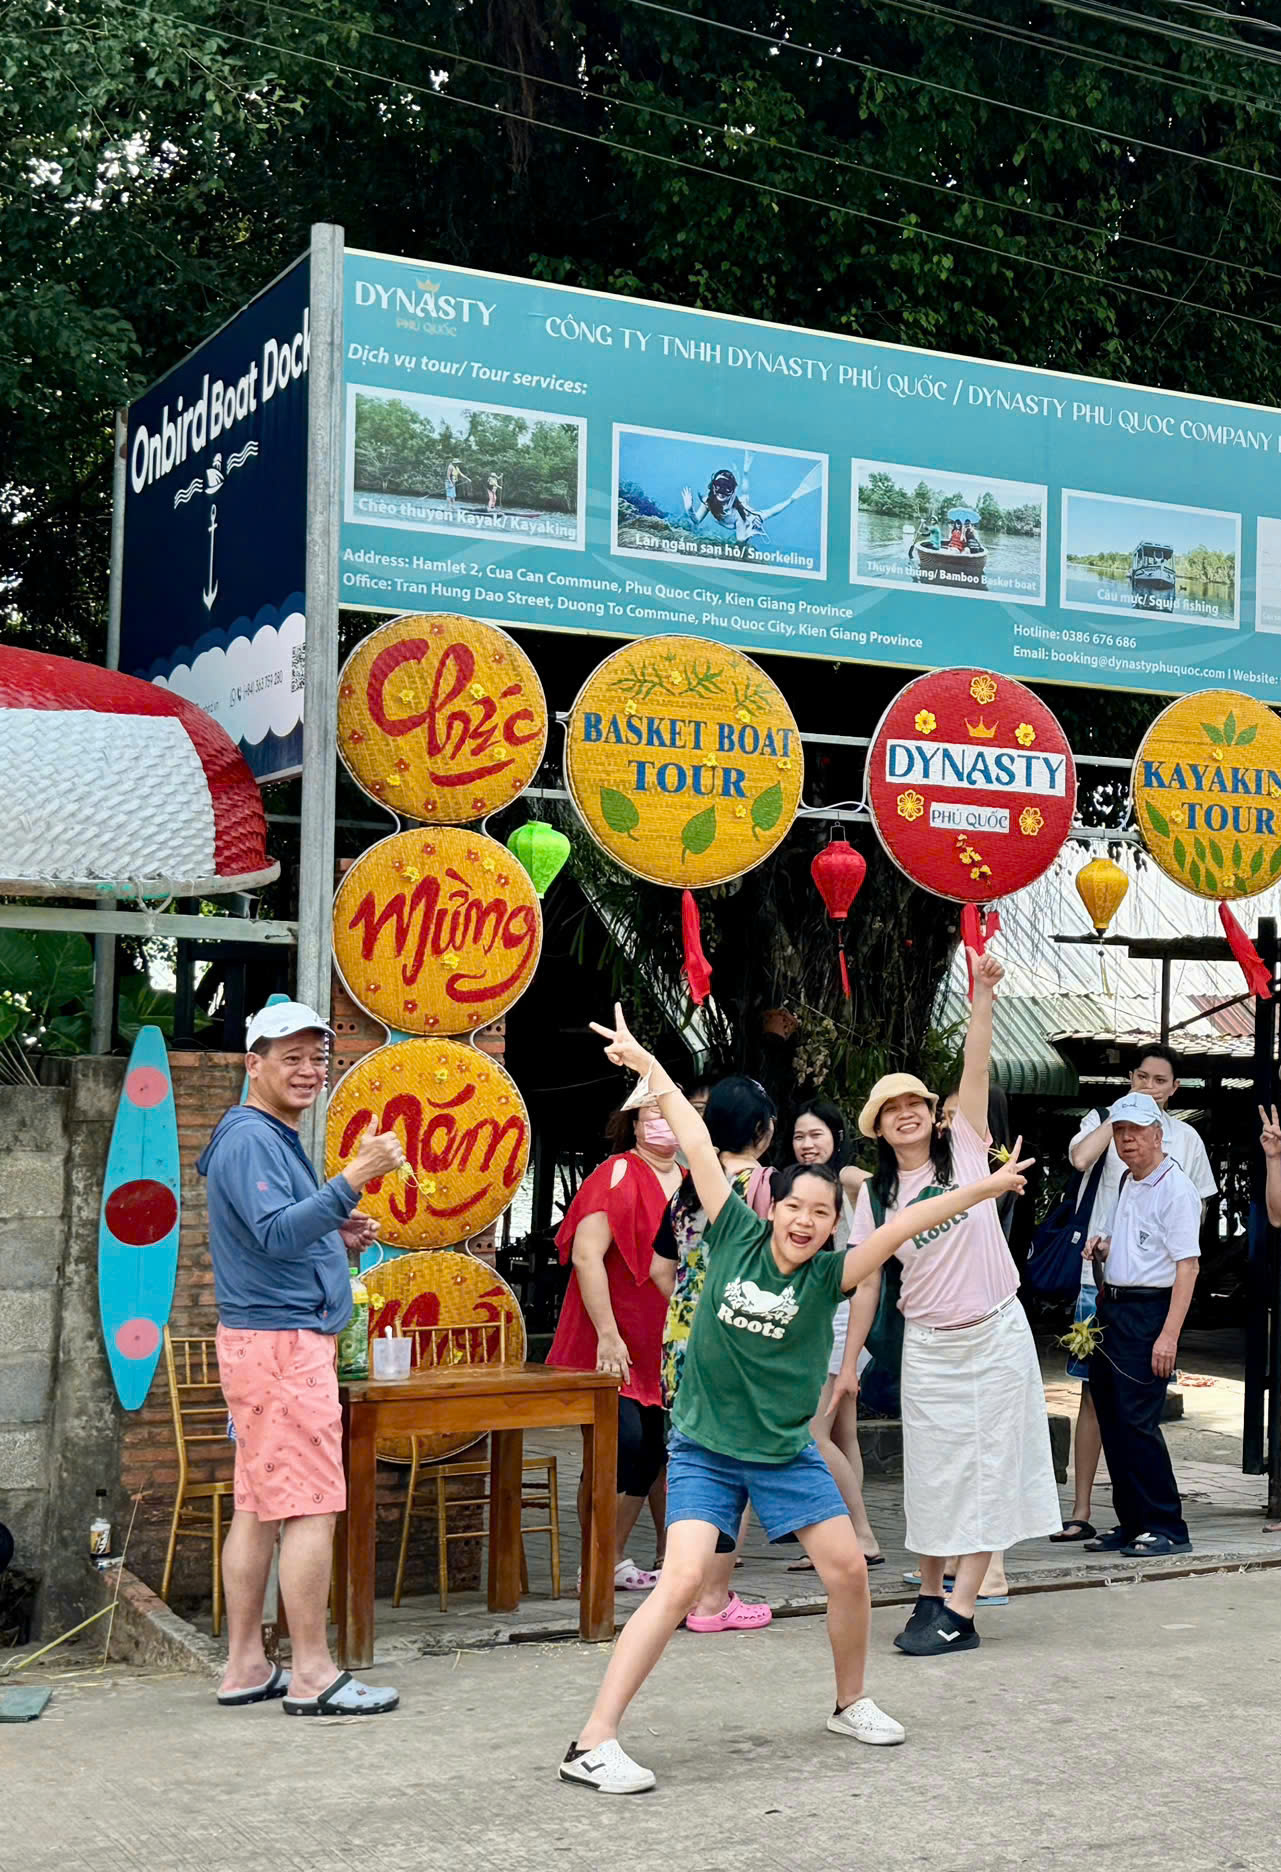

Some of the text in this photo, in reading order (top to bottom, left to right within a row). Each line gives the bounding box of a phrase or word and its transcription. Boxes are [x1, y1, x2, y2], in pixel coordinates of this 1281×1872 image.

[355, 280, 496, 326] DYNASTY
[347, 343, 588, 395] Dịch vụ tour/ Tour services:
[545, 314, 612, 346] CÔNG
[619, 328, 652, 351] TY
[658, 334, 721, 364] TNHH
[728, 347, 832, 382] DYNASTY
[839, 364, 881, 390] PHÚ
[887, 373, 947, 401] QUỐC
[969, 385, 1067, 419] DYNASTY
[1073, 402, 1113, 426] PHU
[1118, 410, 1175, 436] QUOC
[1180, 420, 1272, 452] COMPANY
[131, 373, 210, 494] Onbird
[210, 361, 258, 440] Boat
[510, 516, 578, 539] Kayaking
[700, 543, 722, 555] san
[747, 547, 814, 569] Snorkeling
[343, 548, 853, 618] Address: Hamlet 2, Cua Can Commune, Phu Quoc City, Kien Giang Province
[939, 569, 980, 584] Bamboo
[343, 573, 923, 648] Office: Tran Hung Dao Street, Duong To Commune, Phu Quoc City, Kien Giang Province
[1149, 595, 1180, 609] Squid
[1183, 599, 1219, 616] fishing
[1013, 624, 1137, 649] Hotline: 0386 676 686
[1013, 646, 1049, 661] Email:
[1051, 649, 1226, 679] booking@dynastyphuquoc.com
[1233, 669, 1279, 685] Website:
[583, 711, 795, 758] BASKET BOAT
[628, 760, 748, 799] TOUR
[889, 744, 1064, 790] DYNASTY
[932, 808, 1008, 829] PHÚ QUỐC
[1182, 802, 1276, 836] TOUR
[348, 867, 538, 1003] Mừng
[717, 1302, 785, 1340] Roots
